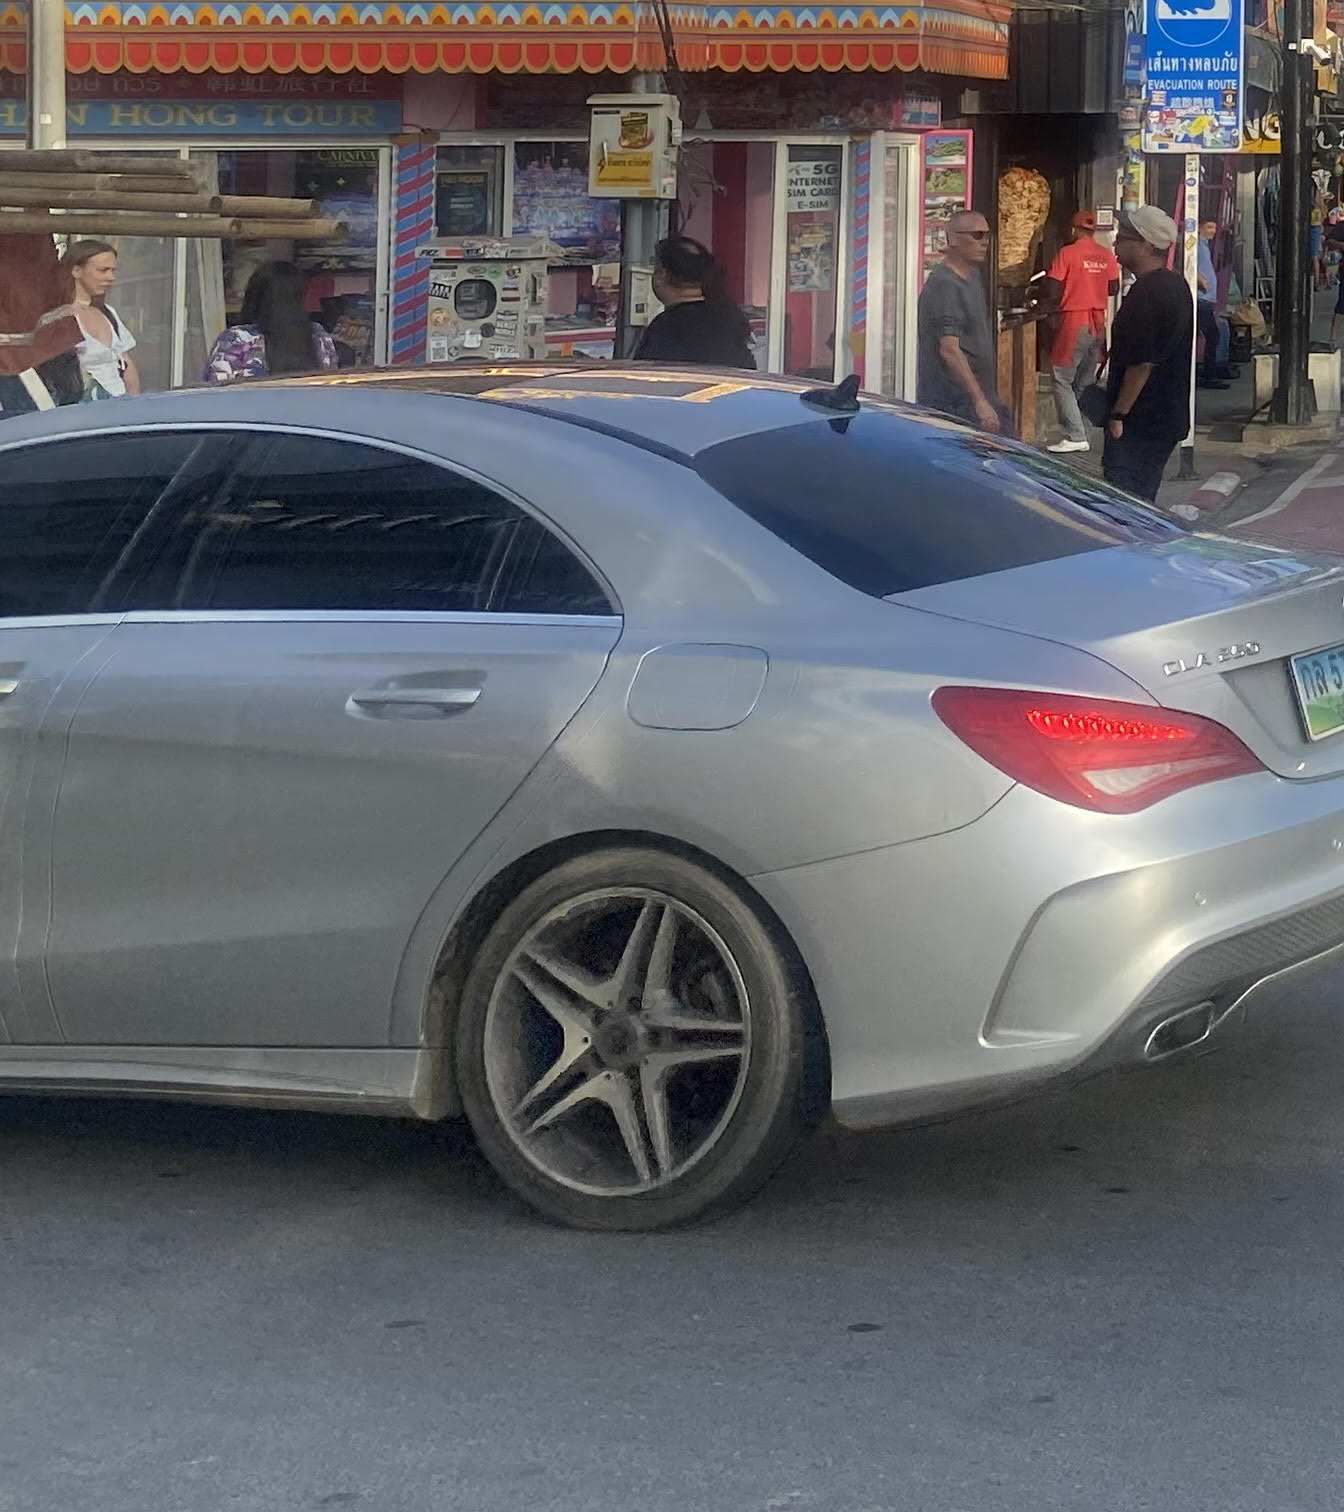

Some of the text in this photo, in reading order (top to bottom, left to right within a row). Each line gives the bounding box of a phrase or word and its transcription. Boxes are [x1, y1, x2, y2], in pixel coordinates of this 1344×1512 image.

[1148, 50, 1238, 73] เส้นทางหลบภัย
[1148, 79, 1238, 91] EVACUATION ROUTE
[110, 103, 236, 127] HONG
[257, 104, 376, 126] TOUR
[813, 163, 839, 175] 5G
[787, 188, 839, 198] SIM CARD
[797, 199, 829, 209] E-SIM
[1163, 652, 1213, 677] CLA
